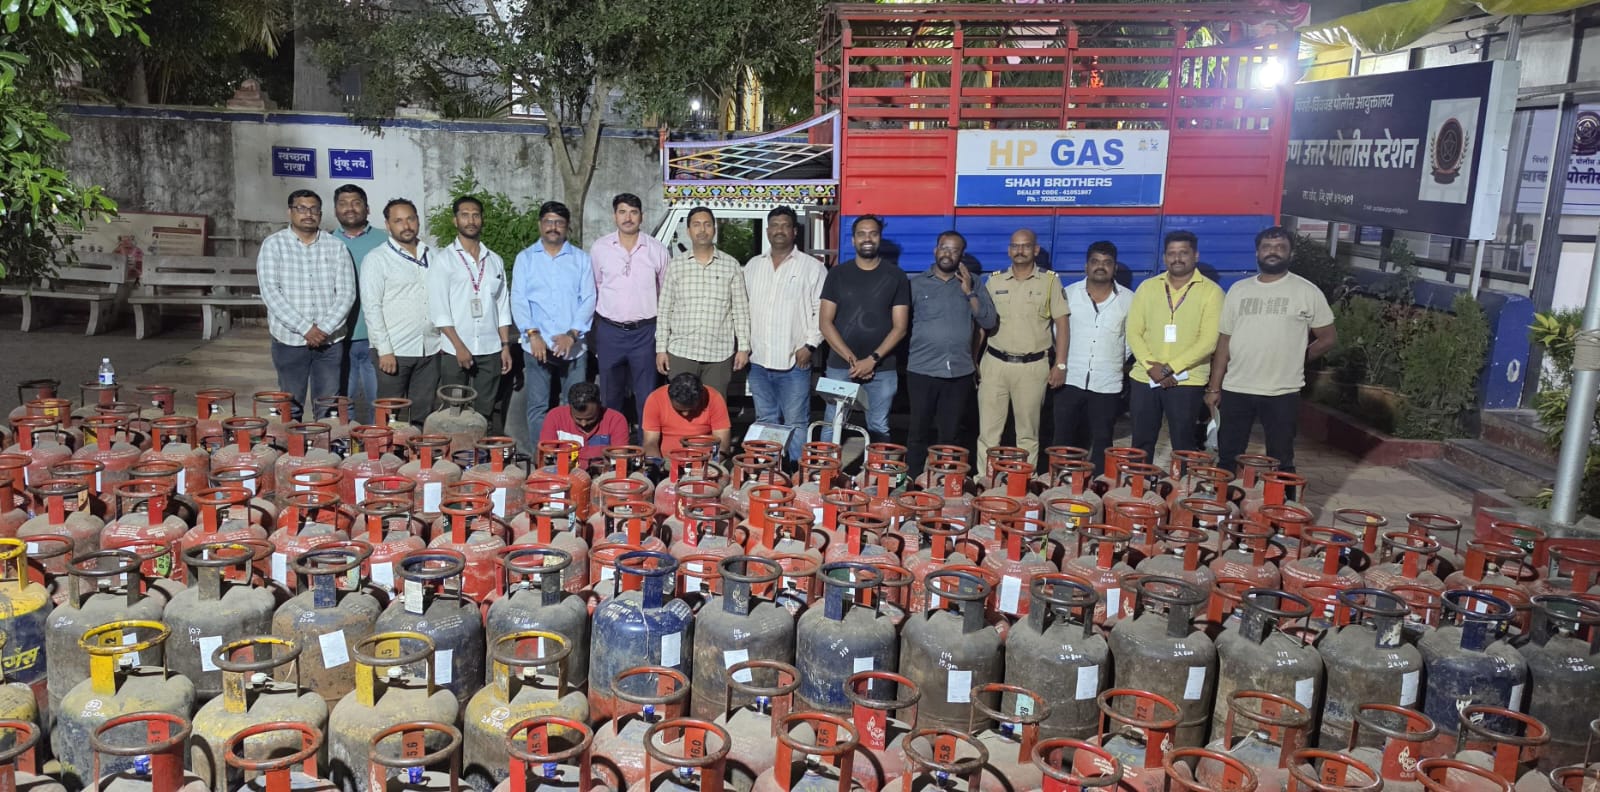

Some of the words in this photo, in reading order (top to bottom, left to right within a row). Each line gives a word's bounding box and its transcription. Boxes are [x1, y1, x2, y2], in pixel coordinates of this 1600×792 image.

[1334, 93, 1355, 110] पोलीस
[1355, 94, 1394, 114] आयुक्तालय
[989, 139, 1038, 167] HP
[1050, 138, 1124, 167] GAS
[1303, 139, 1328, 166] उत्तर
[1328, 128, 1373, 167] पोलीस
[1374, 128, 1419, 168] स्टेशन
[278, 151, 311, 162] स्वच्छता
[283, 162, 306, 172] राखा
[1005, 178, 1040, 187] SHAH
[1044, 177, 1113, 187] BROTHERS
